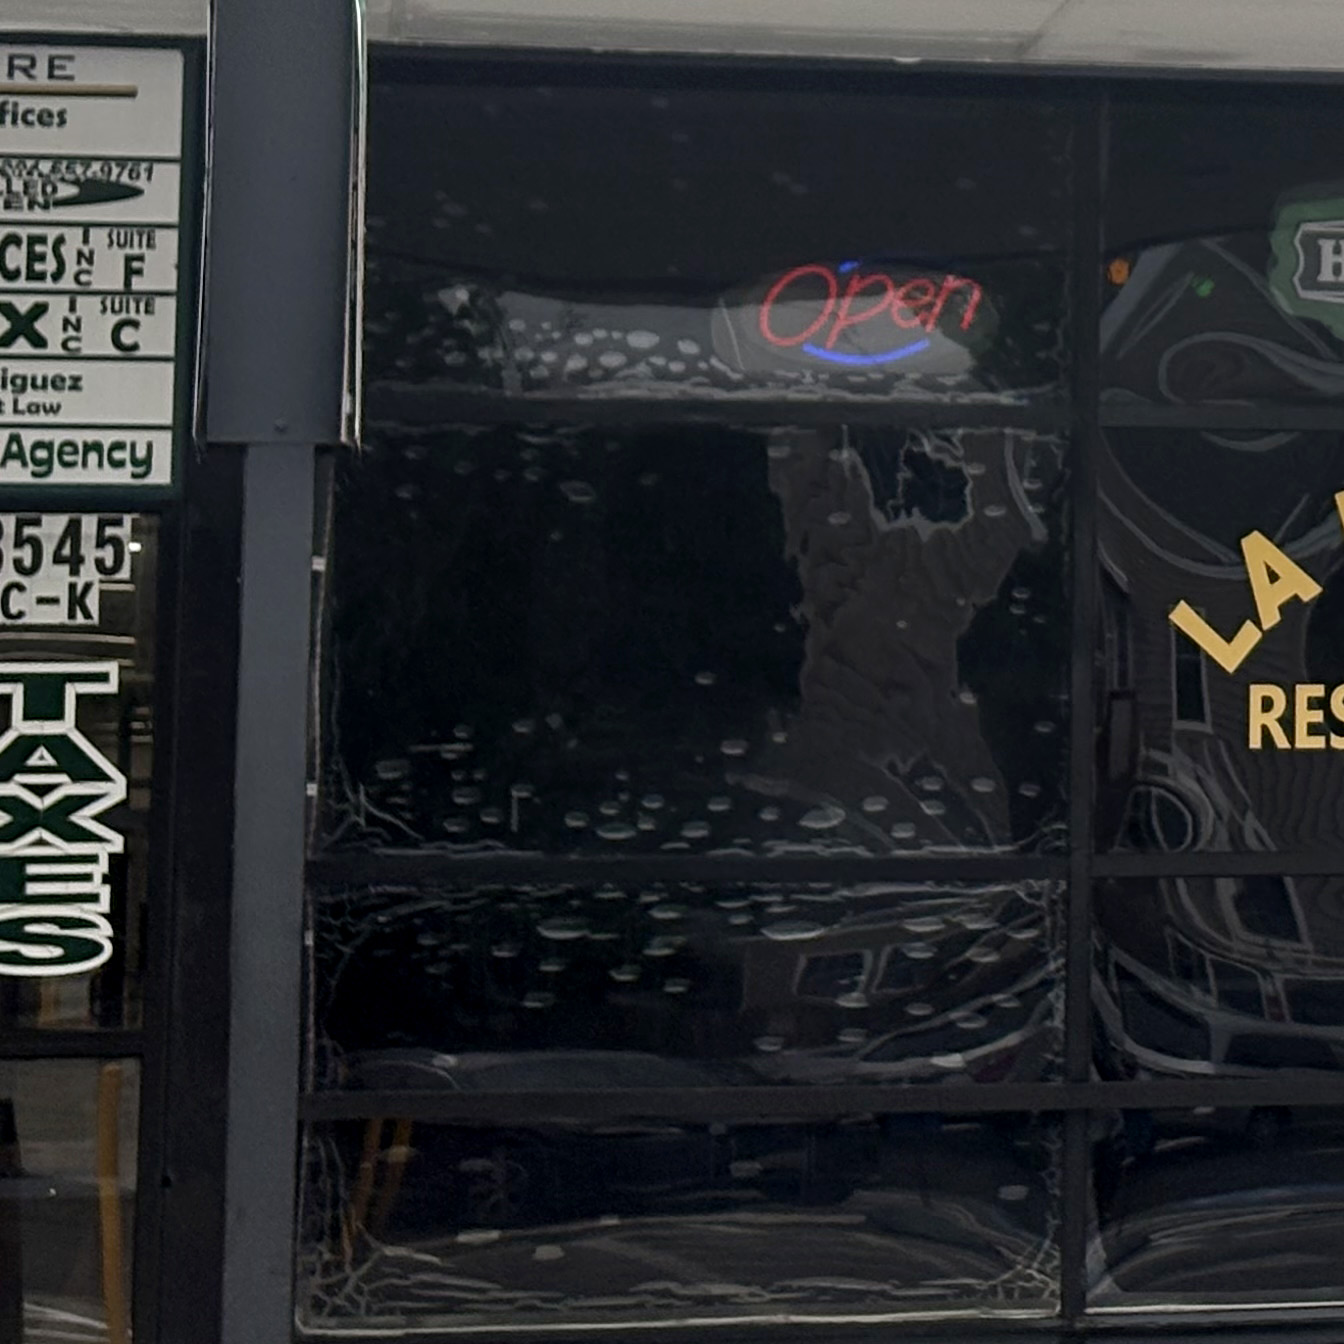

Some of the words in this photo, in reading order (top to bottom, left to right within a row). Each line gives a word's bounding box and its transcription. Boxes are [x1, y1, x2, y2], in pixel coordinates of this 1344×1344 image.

[107, 228, 157, 250] SUITE
[122, 252, 146, 292] F
[100, 296, 156, 316] SUITE
[759, 264, 982, 350] Open
[110, 317, 142, 353] C
[12, 396, 63, 416] Law
[0, 431, 154, 480] Agency
[0, 514, 126, 578] 545
[1167, 529, 1323, 675] LA
